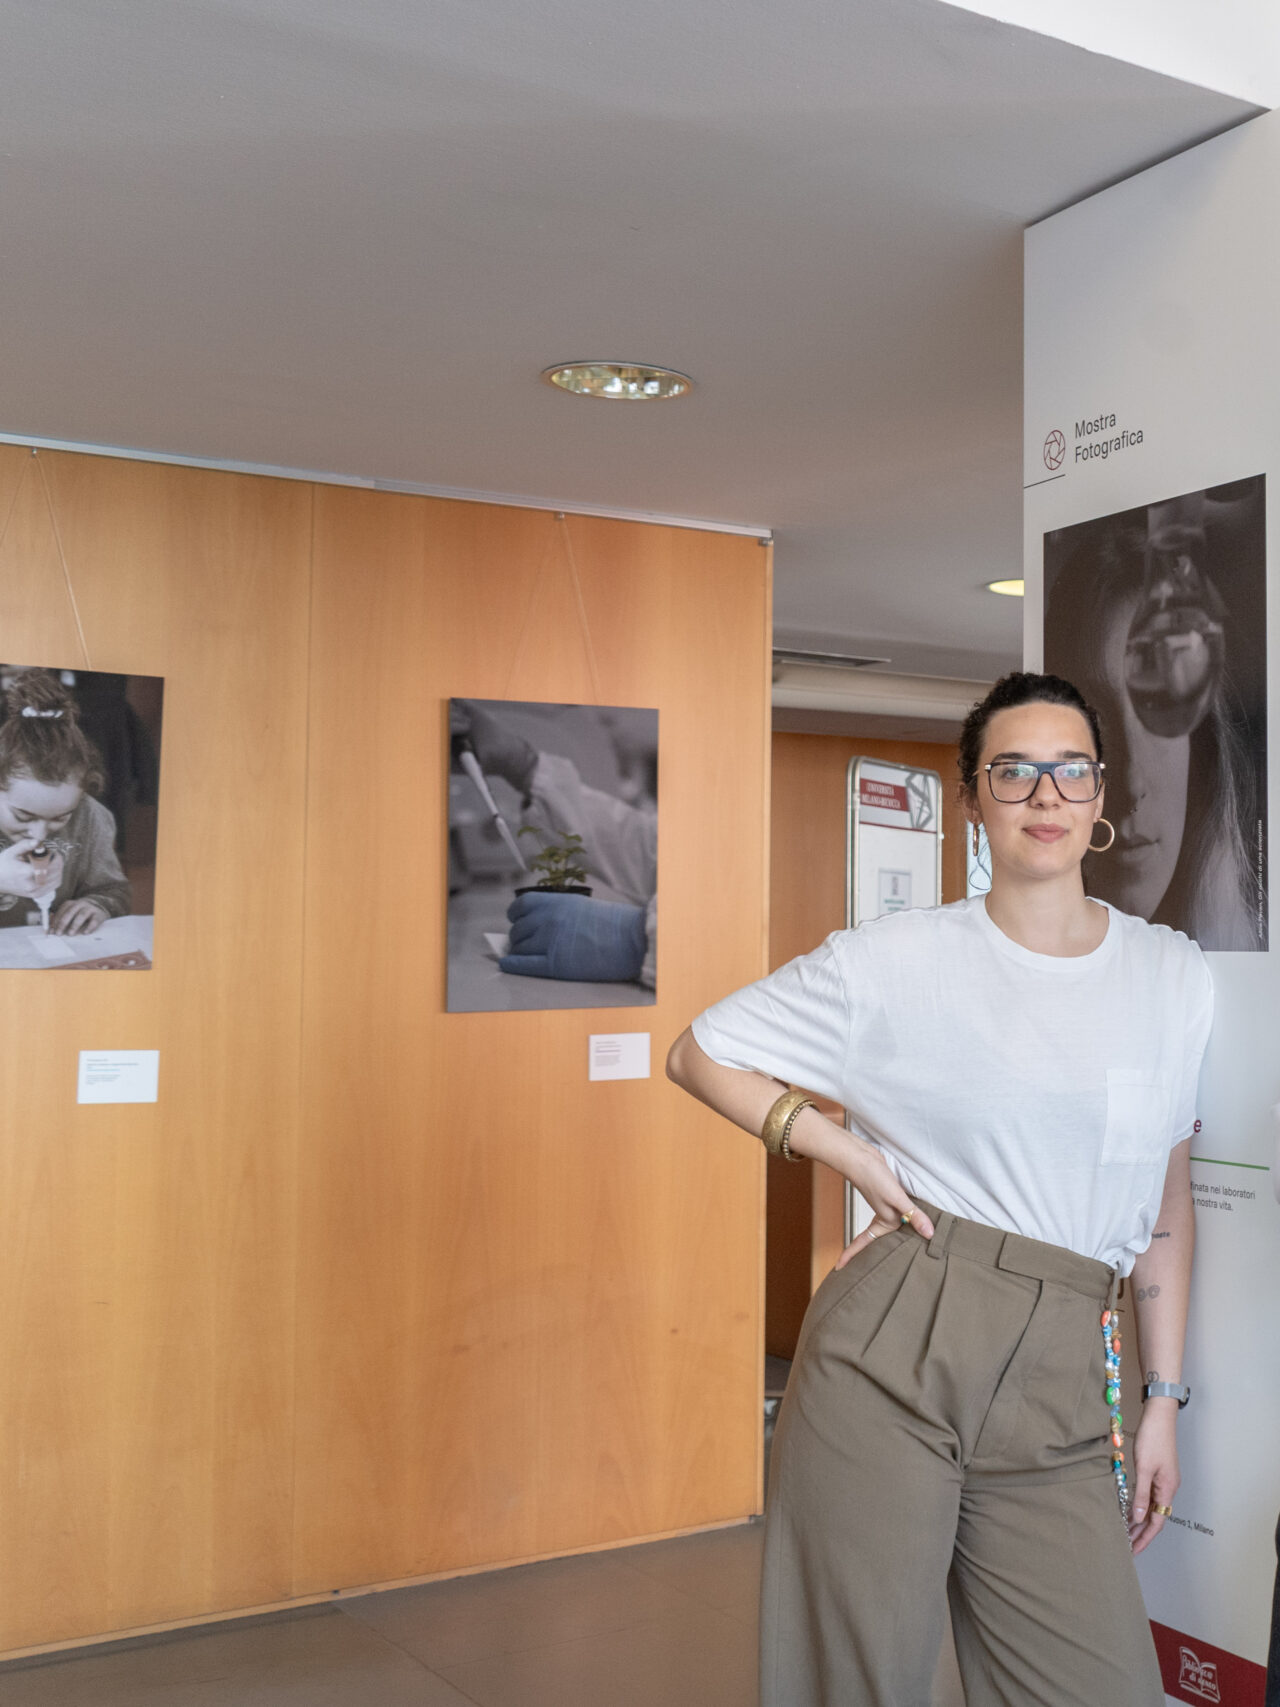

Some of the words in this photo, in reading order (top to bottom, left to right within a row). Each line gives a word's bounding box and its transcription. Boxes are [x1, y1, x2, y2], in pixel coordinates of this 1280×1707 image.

[1075, 413, 1116, 439] Mostra
[1075, 430, 1144, 463] Fotografica
[1210, 1184, 1221, 1195] nei
[1222, 1186, 1256, 1200] laboratori
[1197, 1197, 1218, 1209] nostra
[1219, 1200, 1234, 1211] vita.
[1187, 1520, 1193, 1531] 1,
[1194, 1521, 1215, 1537] Milano
